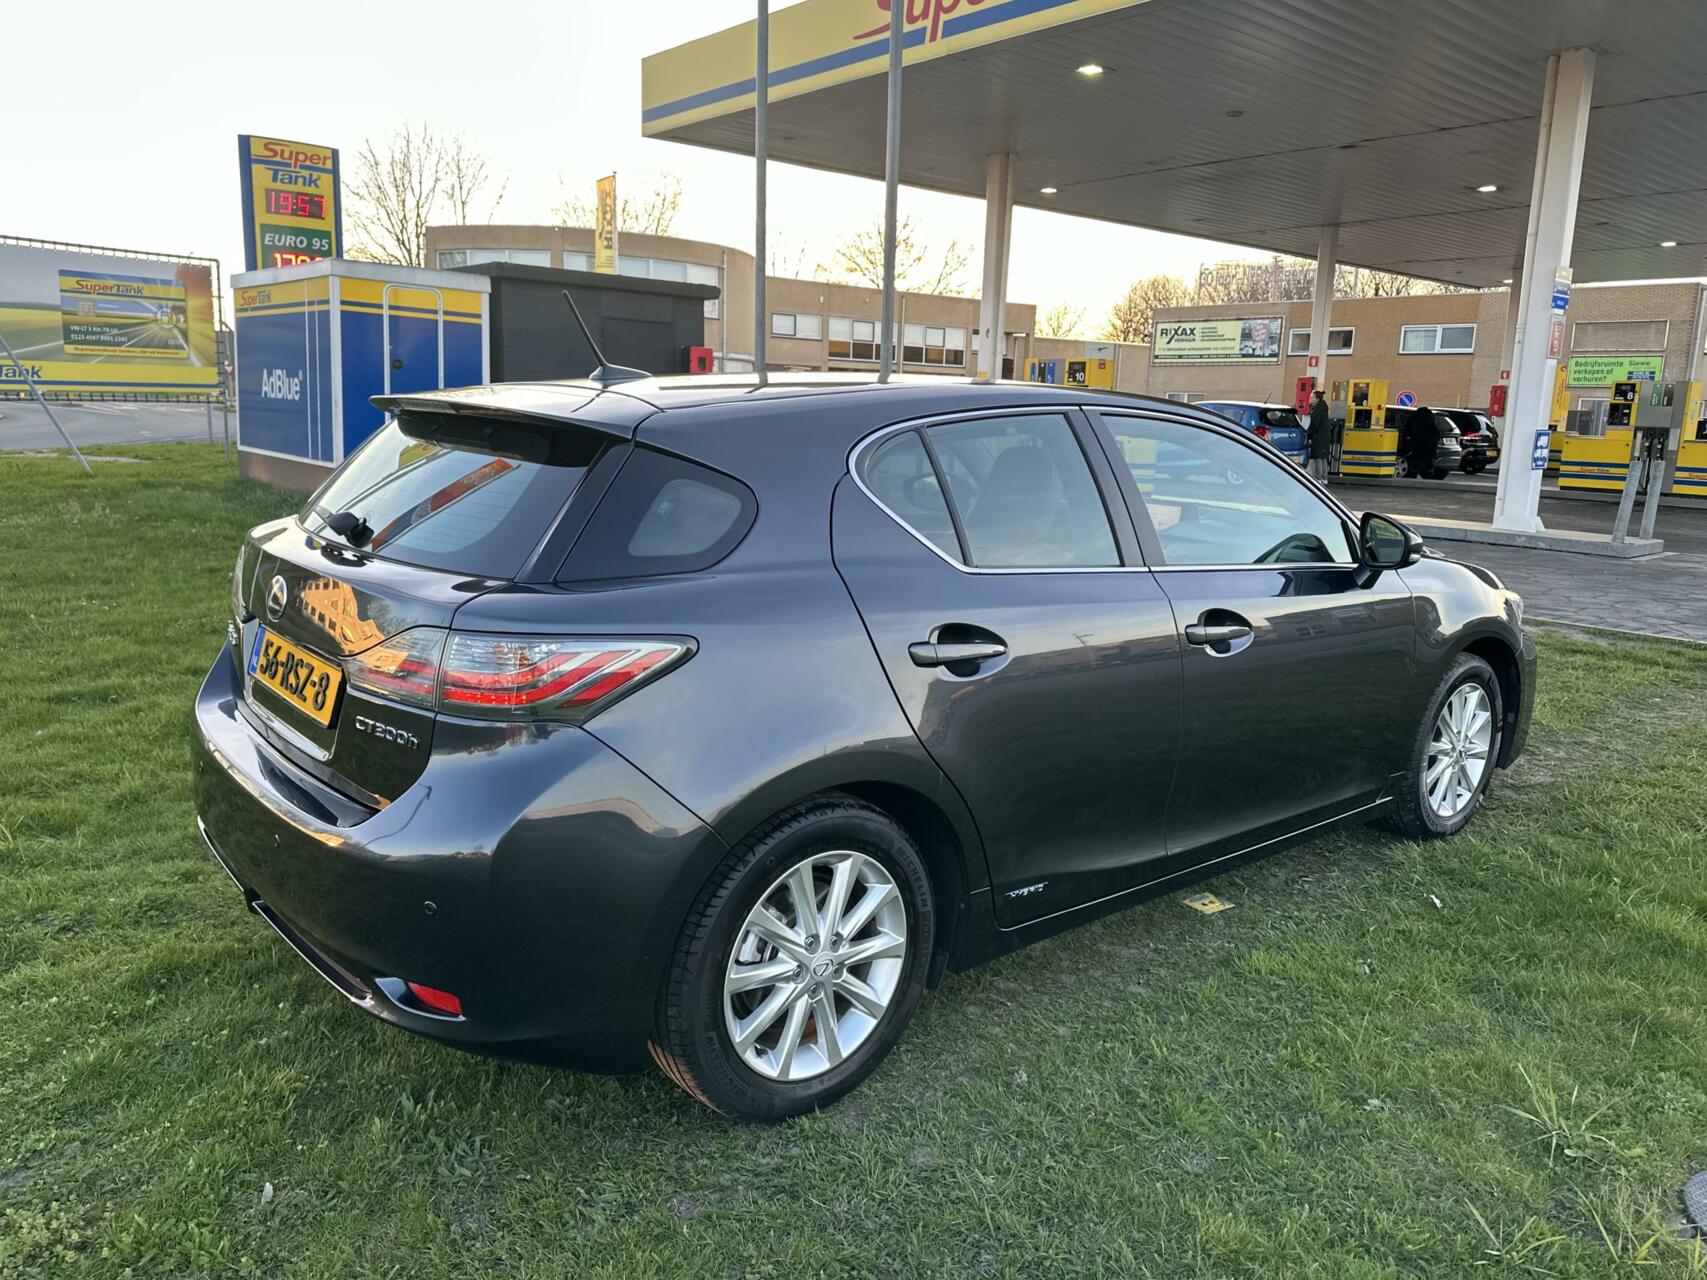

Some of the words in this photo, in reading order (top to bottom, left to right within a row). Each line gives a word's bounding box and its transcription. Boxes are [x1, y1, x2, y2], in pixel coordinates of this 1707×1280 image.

[252, 141, 331, 168] Super
[265, 167, 320, 188] Tank
[271, 191, 326, 218] 19:57
[264, 233, 307, 249] EURO
[312, 238, 329, 251] 95
[1160, 326, 1197, 344] RIXAX
[1575, 360, 1624, 368] Bedrijfsruimte
[1075, 372, 1085, 382] 10
[1626, 391, 1634, 400] 8
[259, 639, 330, 712] 56-RSZ-8
[898, 846, 929, 909] MICHELIN
